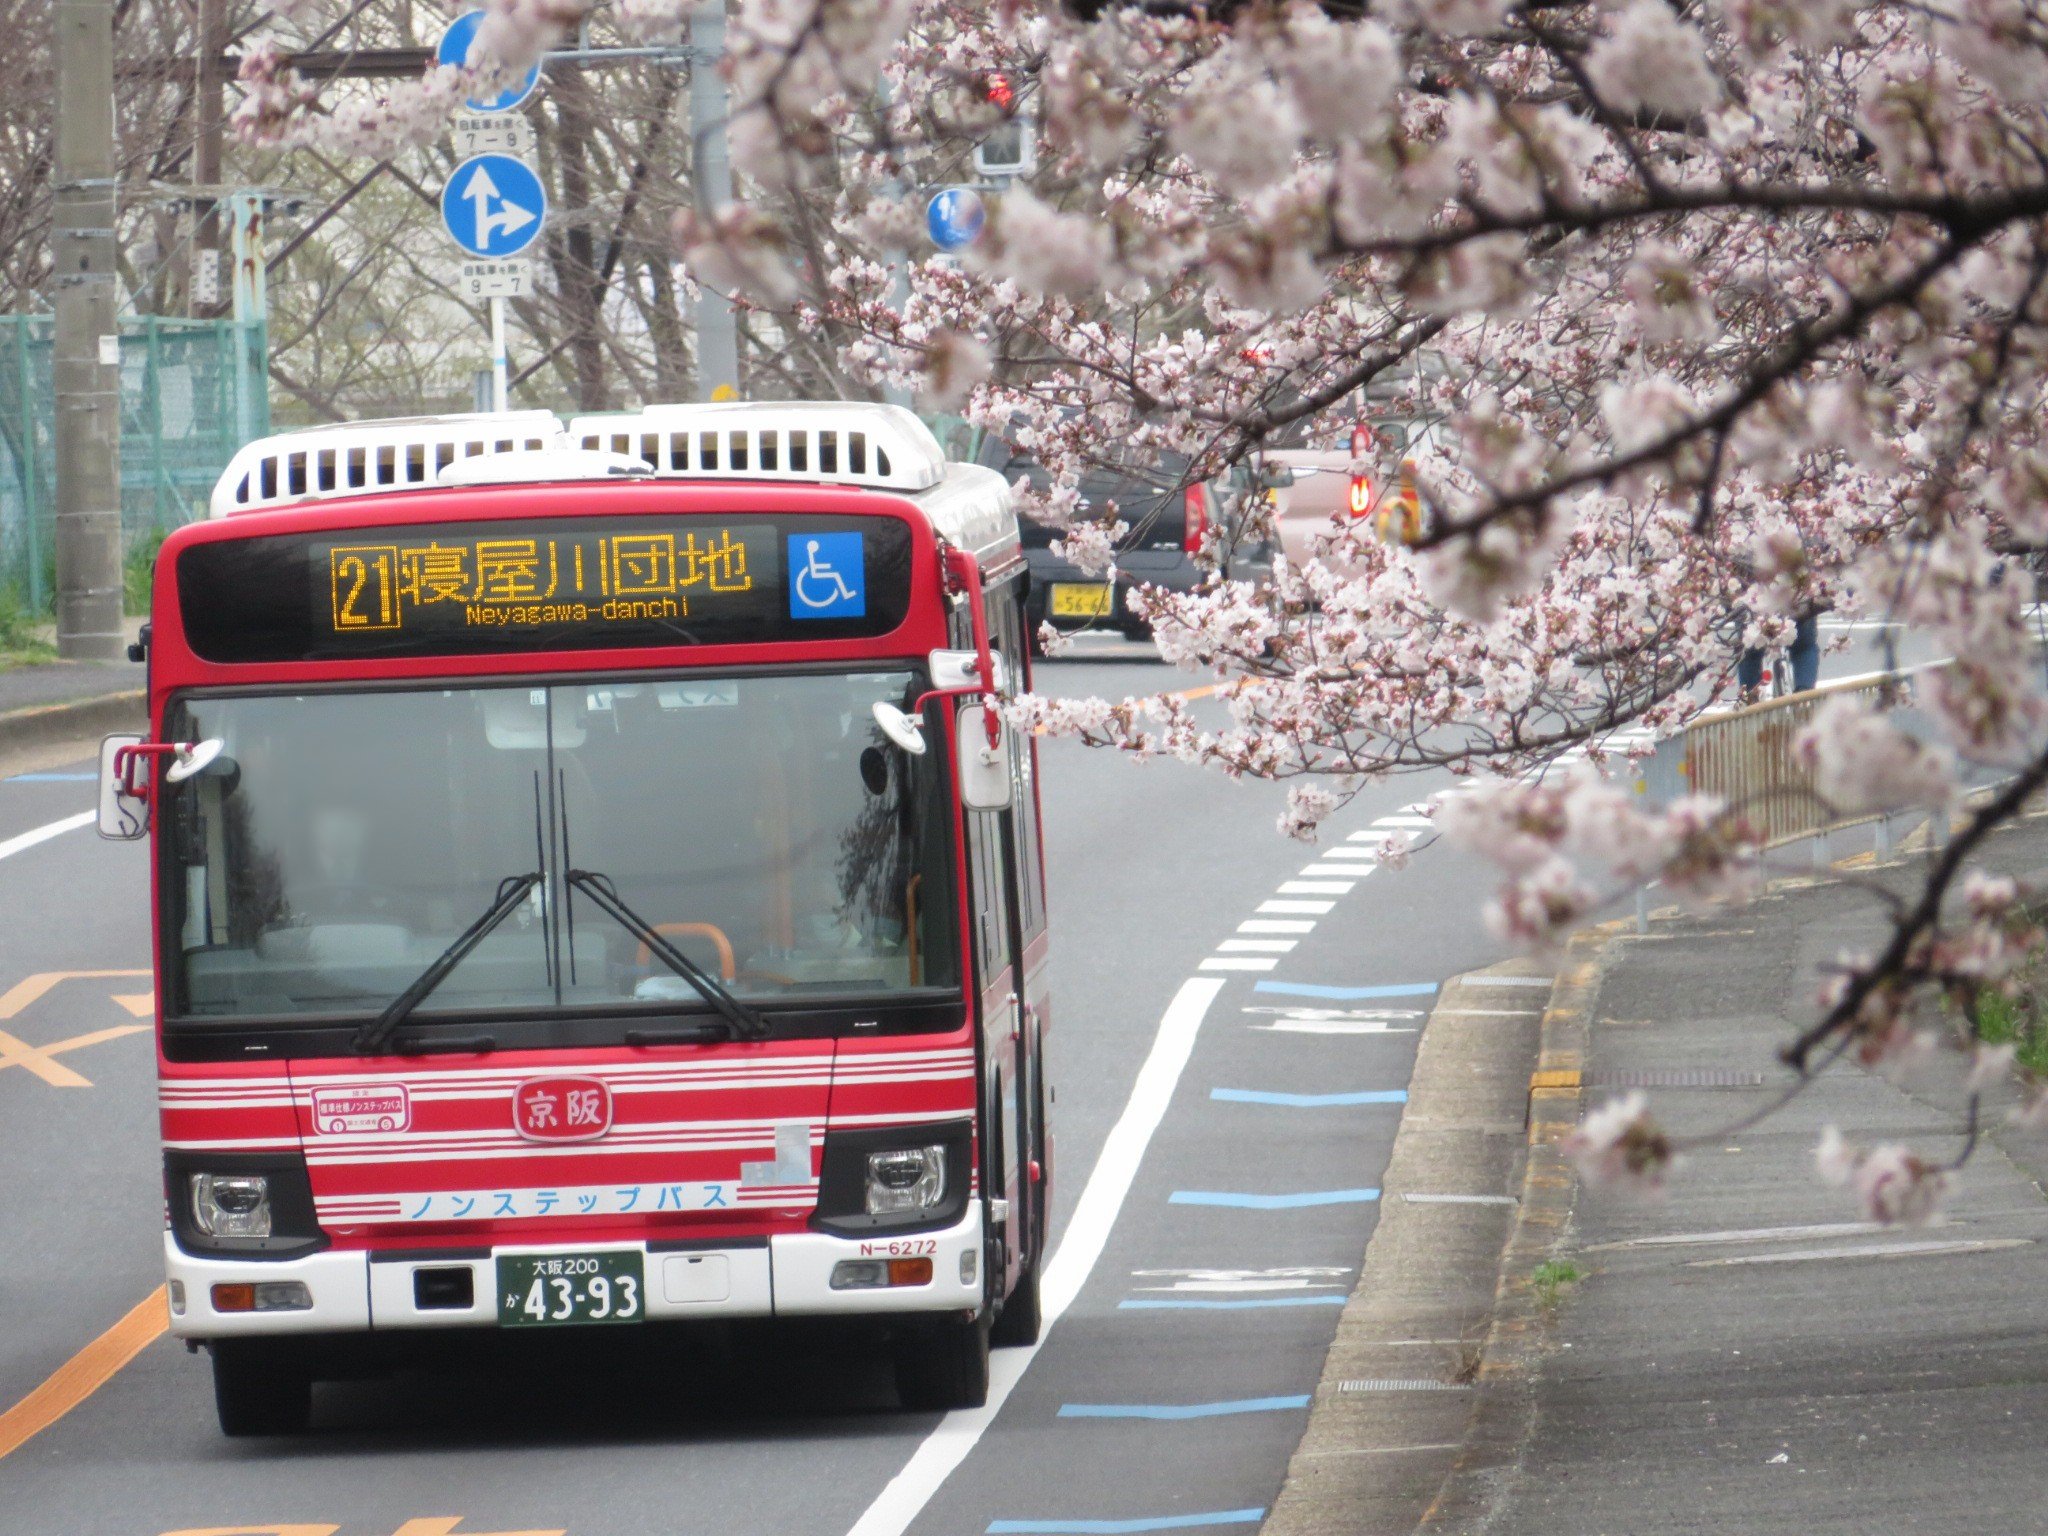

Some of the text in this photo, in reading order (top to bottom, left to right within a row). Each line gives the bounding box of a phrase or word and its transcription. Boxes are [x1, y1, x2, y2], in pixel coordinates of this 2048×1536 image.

[339, 555, 391, 624] 21
[466, 598, 690, 627] Neyagawa-danchi
[523, 1089, 603, 1129] 京阪
[412, 1184, 728, 1219] ノンステップバス
[860, 1239, 938, 1256] N-6272
[505, 1275, 639, 1321] か 43-93
